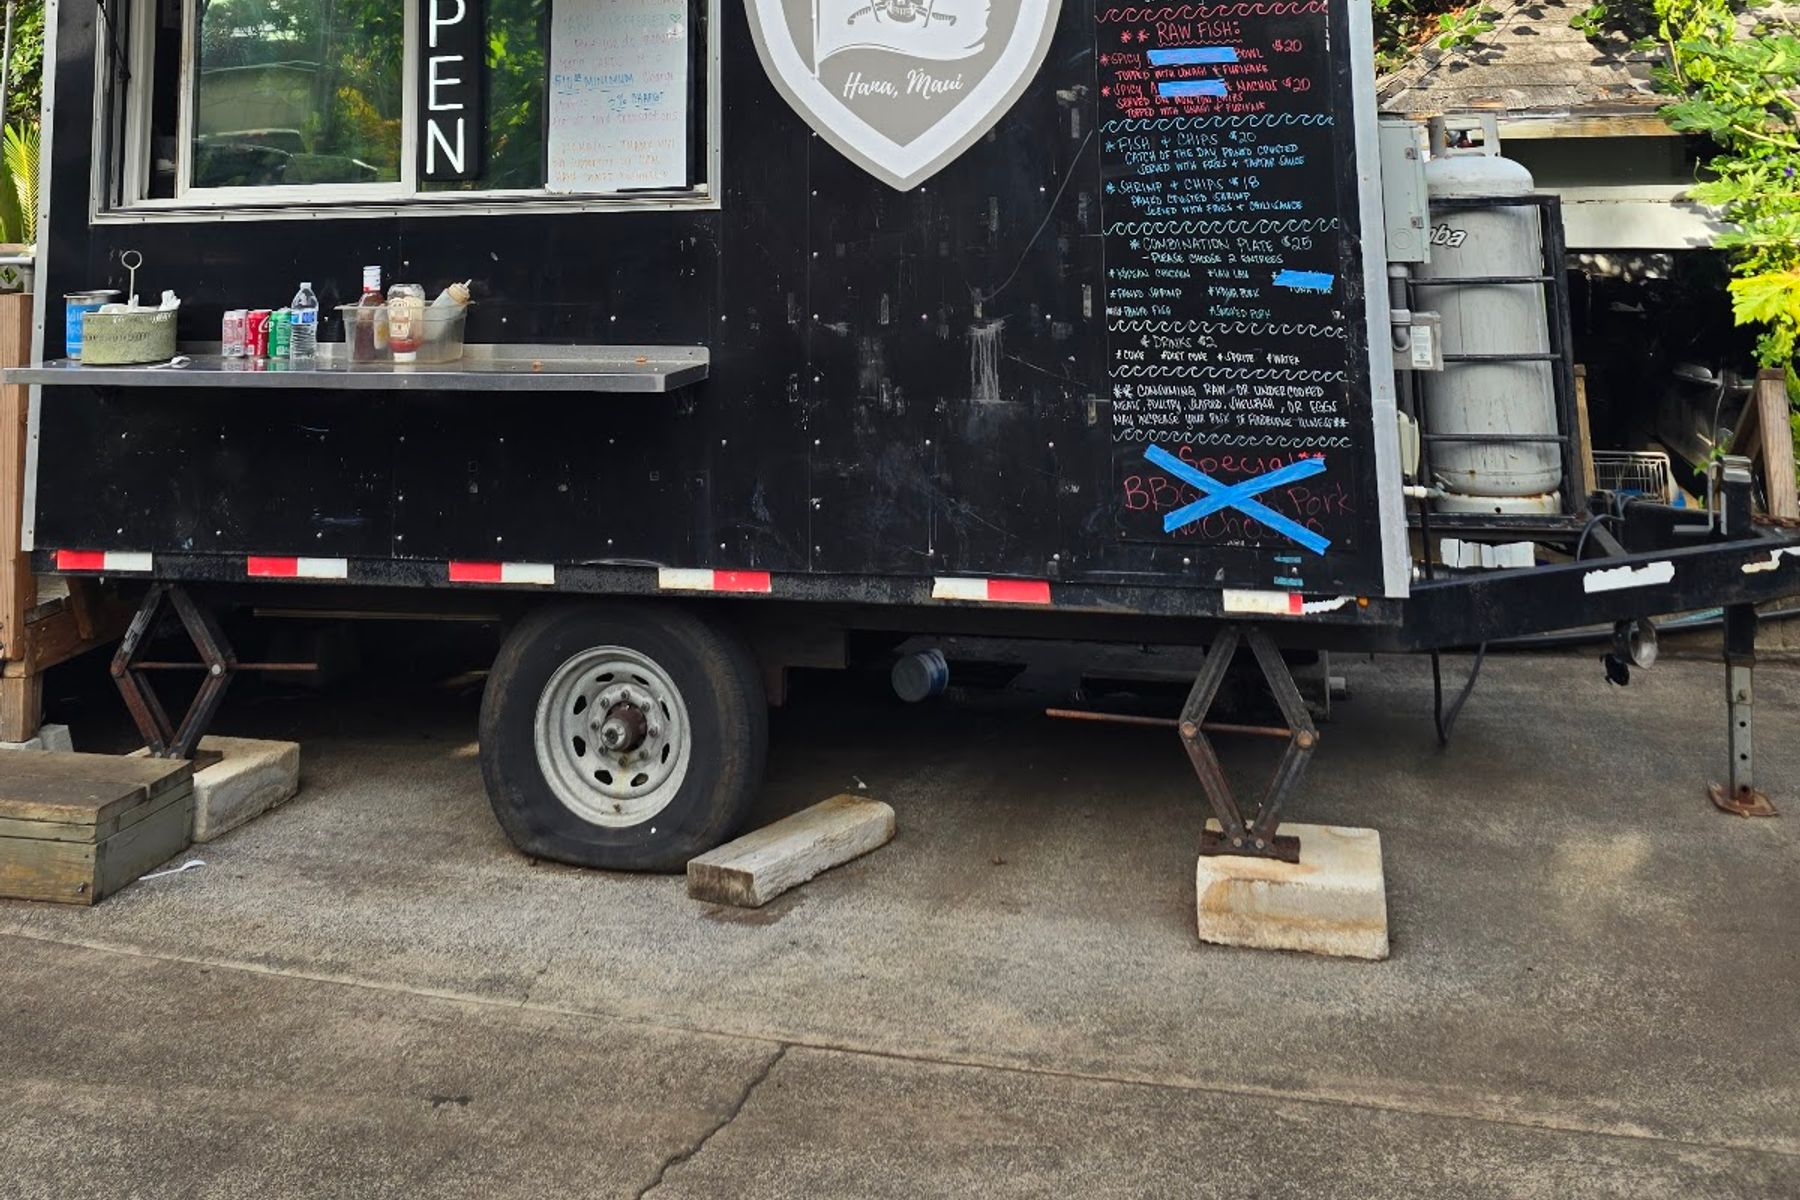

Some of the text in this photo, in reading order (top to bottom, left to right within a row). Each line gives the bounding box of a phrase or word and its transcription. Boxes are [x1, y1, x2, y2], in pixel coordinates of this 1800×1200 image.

[1156, 22, 1192, 43] RAW
[1272, 39, 1302, 52] $20
[1236, 79, 1277, 91] NACHOS
[1282, 76, 1311, 94] $20
[1117, 135, 1150, 152] FISH
[1177, 132, 1218, 146] CHIPS
[1229, 131, 1256, 143] $20
[1125, 151, 1156, 164] CATCH
[1160, 150, 1171, 160] OF
[1173, 148, 1193, 158] THE
[1196, 147, 1217, 160] DAY
[1118, 180, 1162, 194] SHRIMP
[1183, 178, 1224, 191] CHIPS
[1229, 175, 1260, 190] $18
[1143, 236, 1312, 252] COMBINATION PLATE $25
[1229, 253, 1237, 263] 2
[1240, 253, 1283, 264] ENTREES
[1152, 335, 1192, 349] DRINKS
[1123, 350, 1144, 360] COKE
[1224, 351, 1254, 363] SPRITE
[1203, 383, 1225, 396] RAW
[1236, 384, 1249, 396] OR
[1287, 400, 1303, 413] OR
[1310, 400, 1337, 413] EGGS
[1287, 481, 1356, 516] Pork
